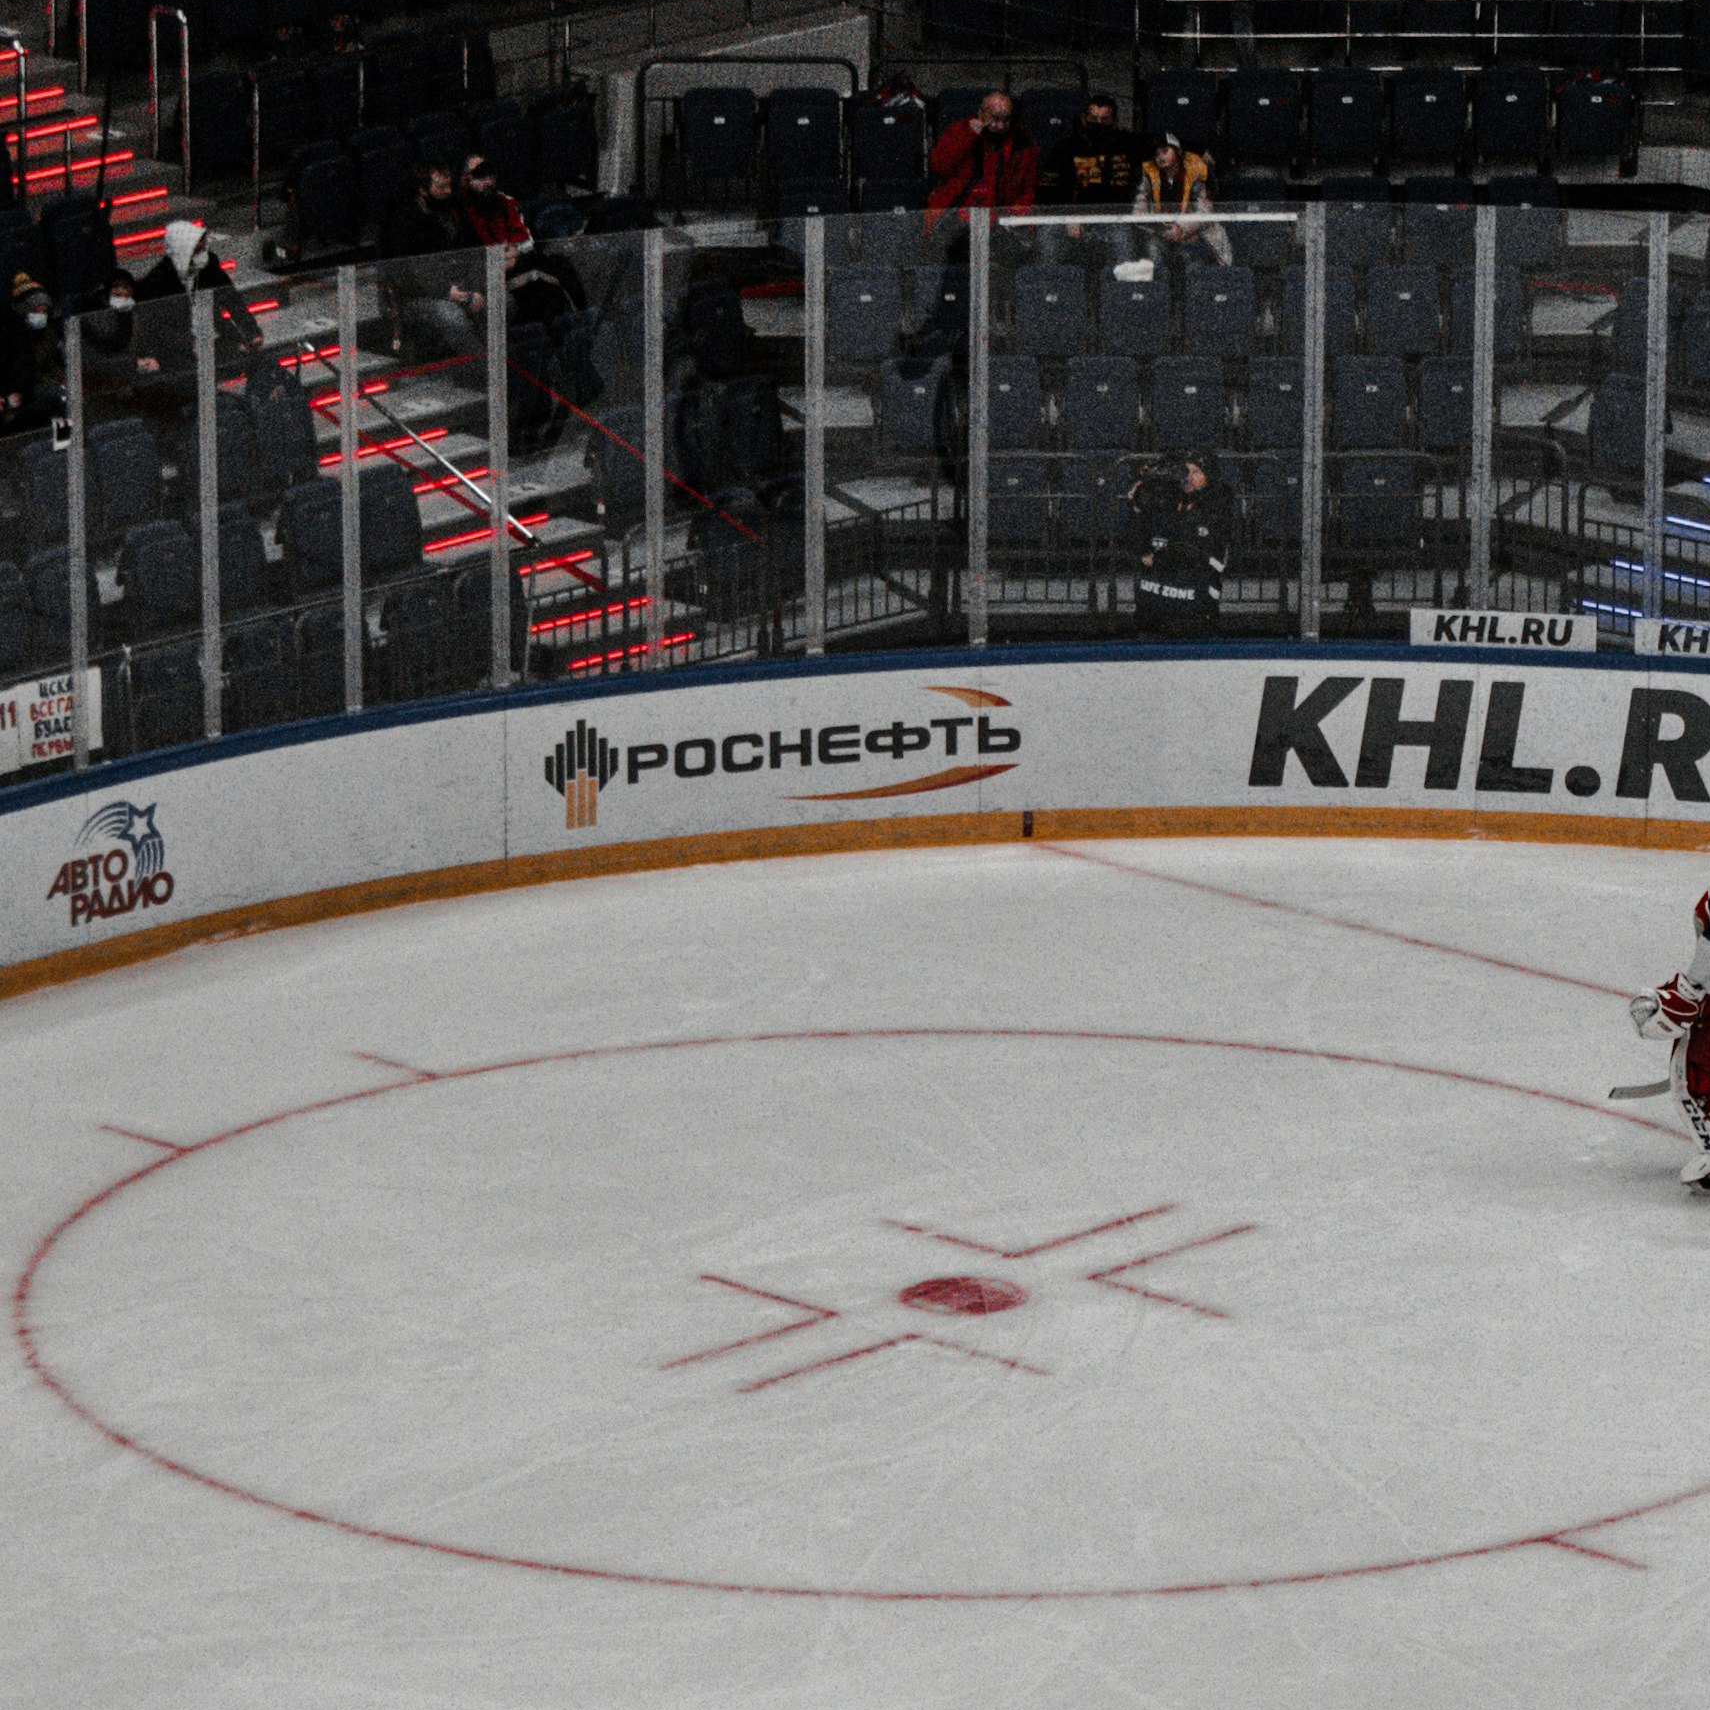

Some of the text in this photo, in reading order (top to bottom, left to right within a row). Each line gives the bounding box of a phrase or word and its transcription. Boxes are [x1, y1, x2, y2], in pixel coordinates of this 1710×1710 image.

[1434, 614, 1574, 647] KHL.RU
[627, 716, 1022, 784] РОСНЕФТЬ
[47, 849, 129, 901] АВТО
[71, 871, 174, 927] РАДИО
